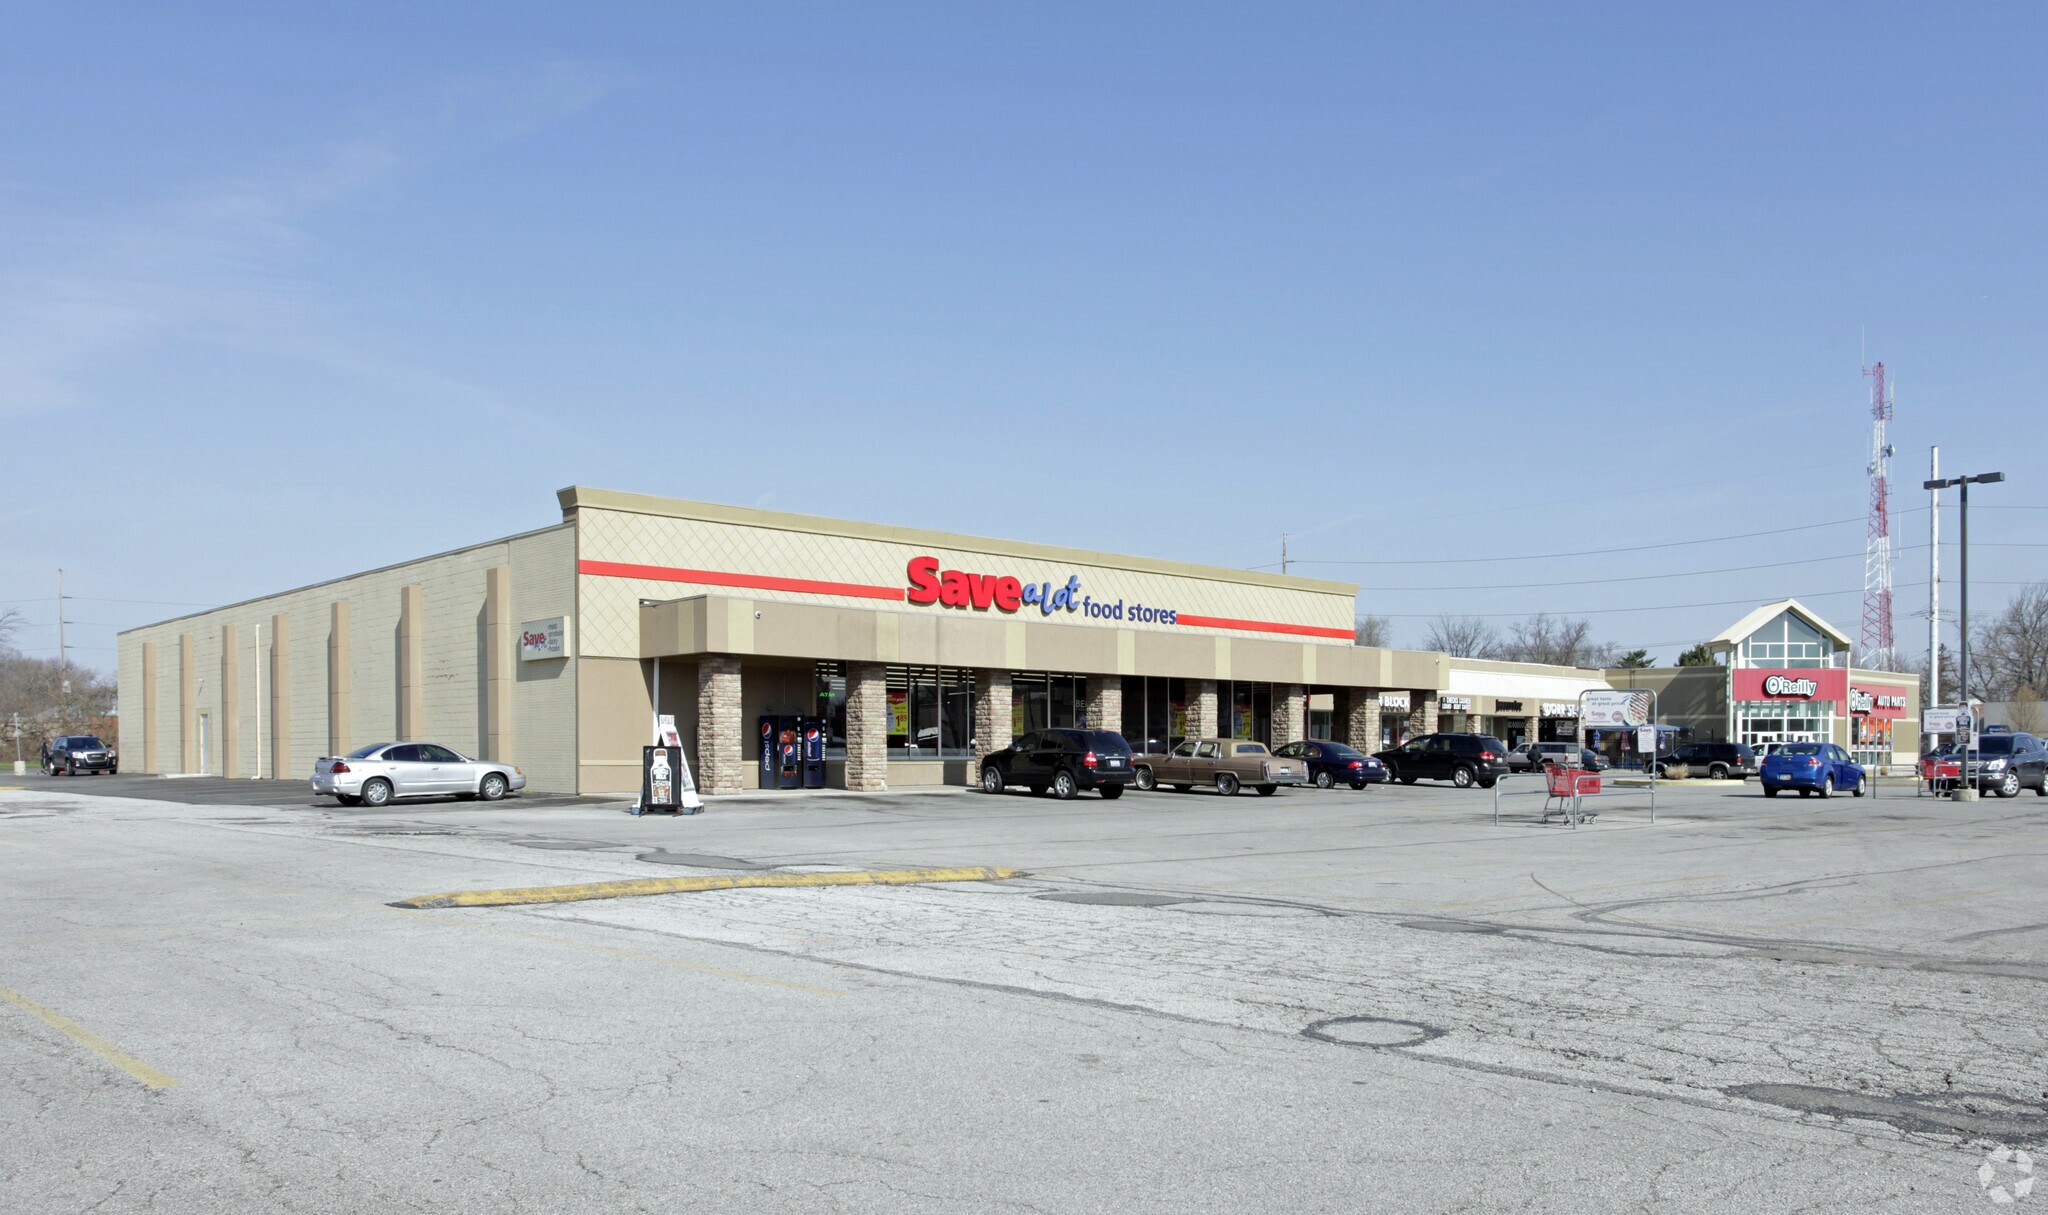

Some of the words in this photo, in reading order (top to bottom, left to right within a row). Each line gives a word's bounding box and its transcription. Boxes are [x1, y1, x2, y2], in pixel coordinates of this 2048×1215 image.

[907, 556, 1022, 611] Save
[1083, 596, 1123, 620] food
[1128, 603, 1177, 625] stores
[523, 630, 545, 647] Save
[1766, 676, 1816, 695] O'Reilly
[1385, 696, 1410, 708] BLOCK
[1850, 688, 1873, 713] O'Reilly
[1878, 695, 1890, 706] AUTO
[1891, 696, 1906, 707] PARTS
